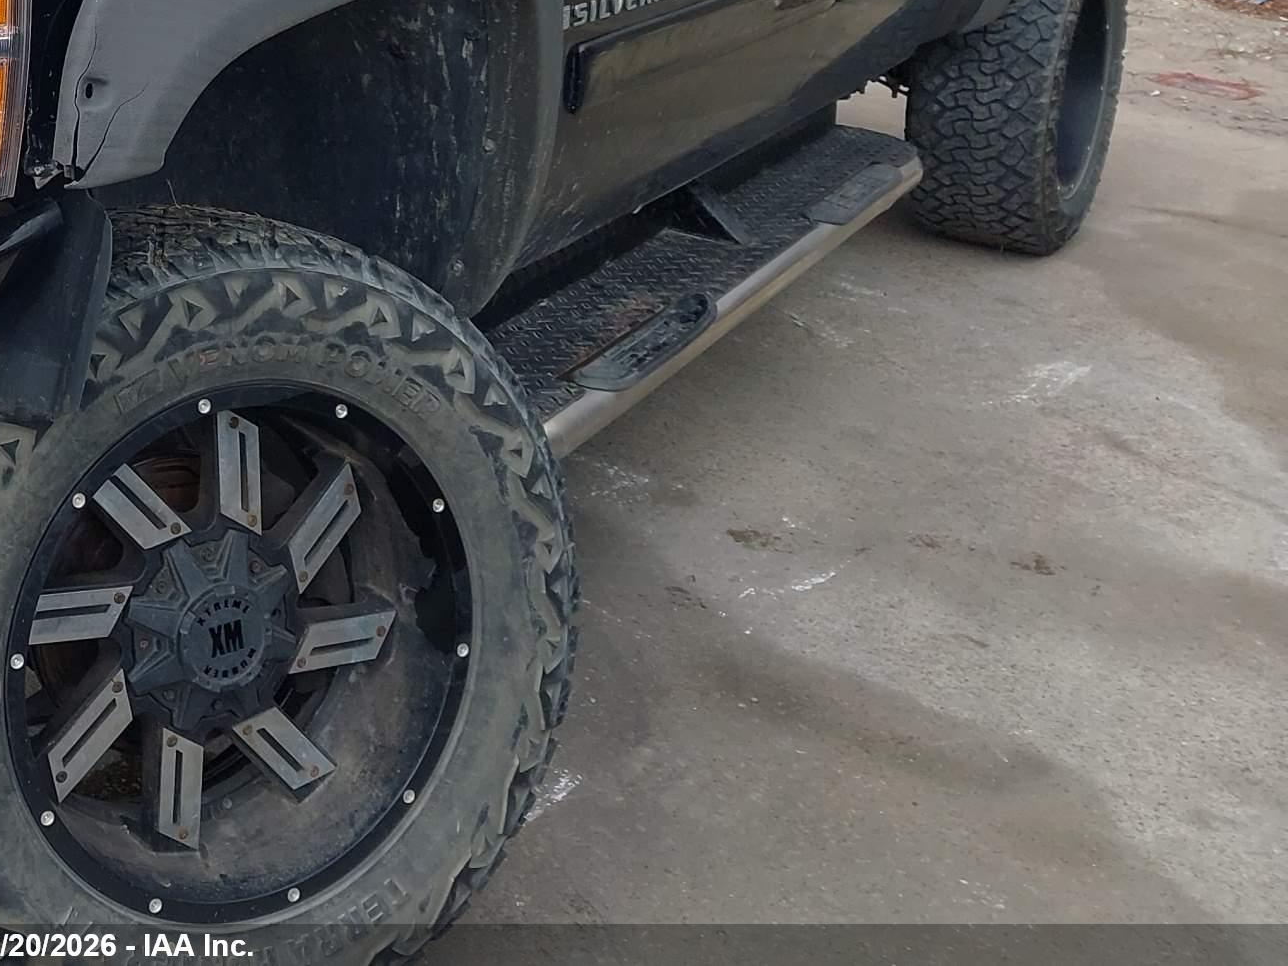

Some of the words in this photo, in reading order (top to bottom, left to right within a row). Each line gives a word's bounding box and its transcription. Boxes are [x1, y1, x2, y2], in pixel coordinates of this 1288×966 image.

[168, 336, 309, 381] VENOM
[317, 338, 441, 415] POWER
[209, 619, 244, 659] XM
